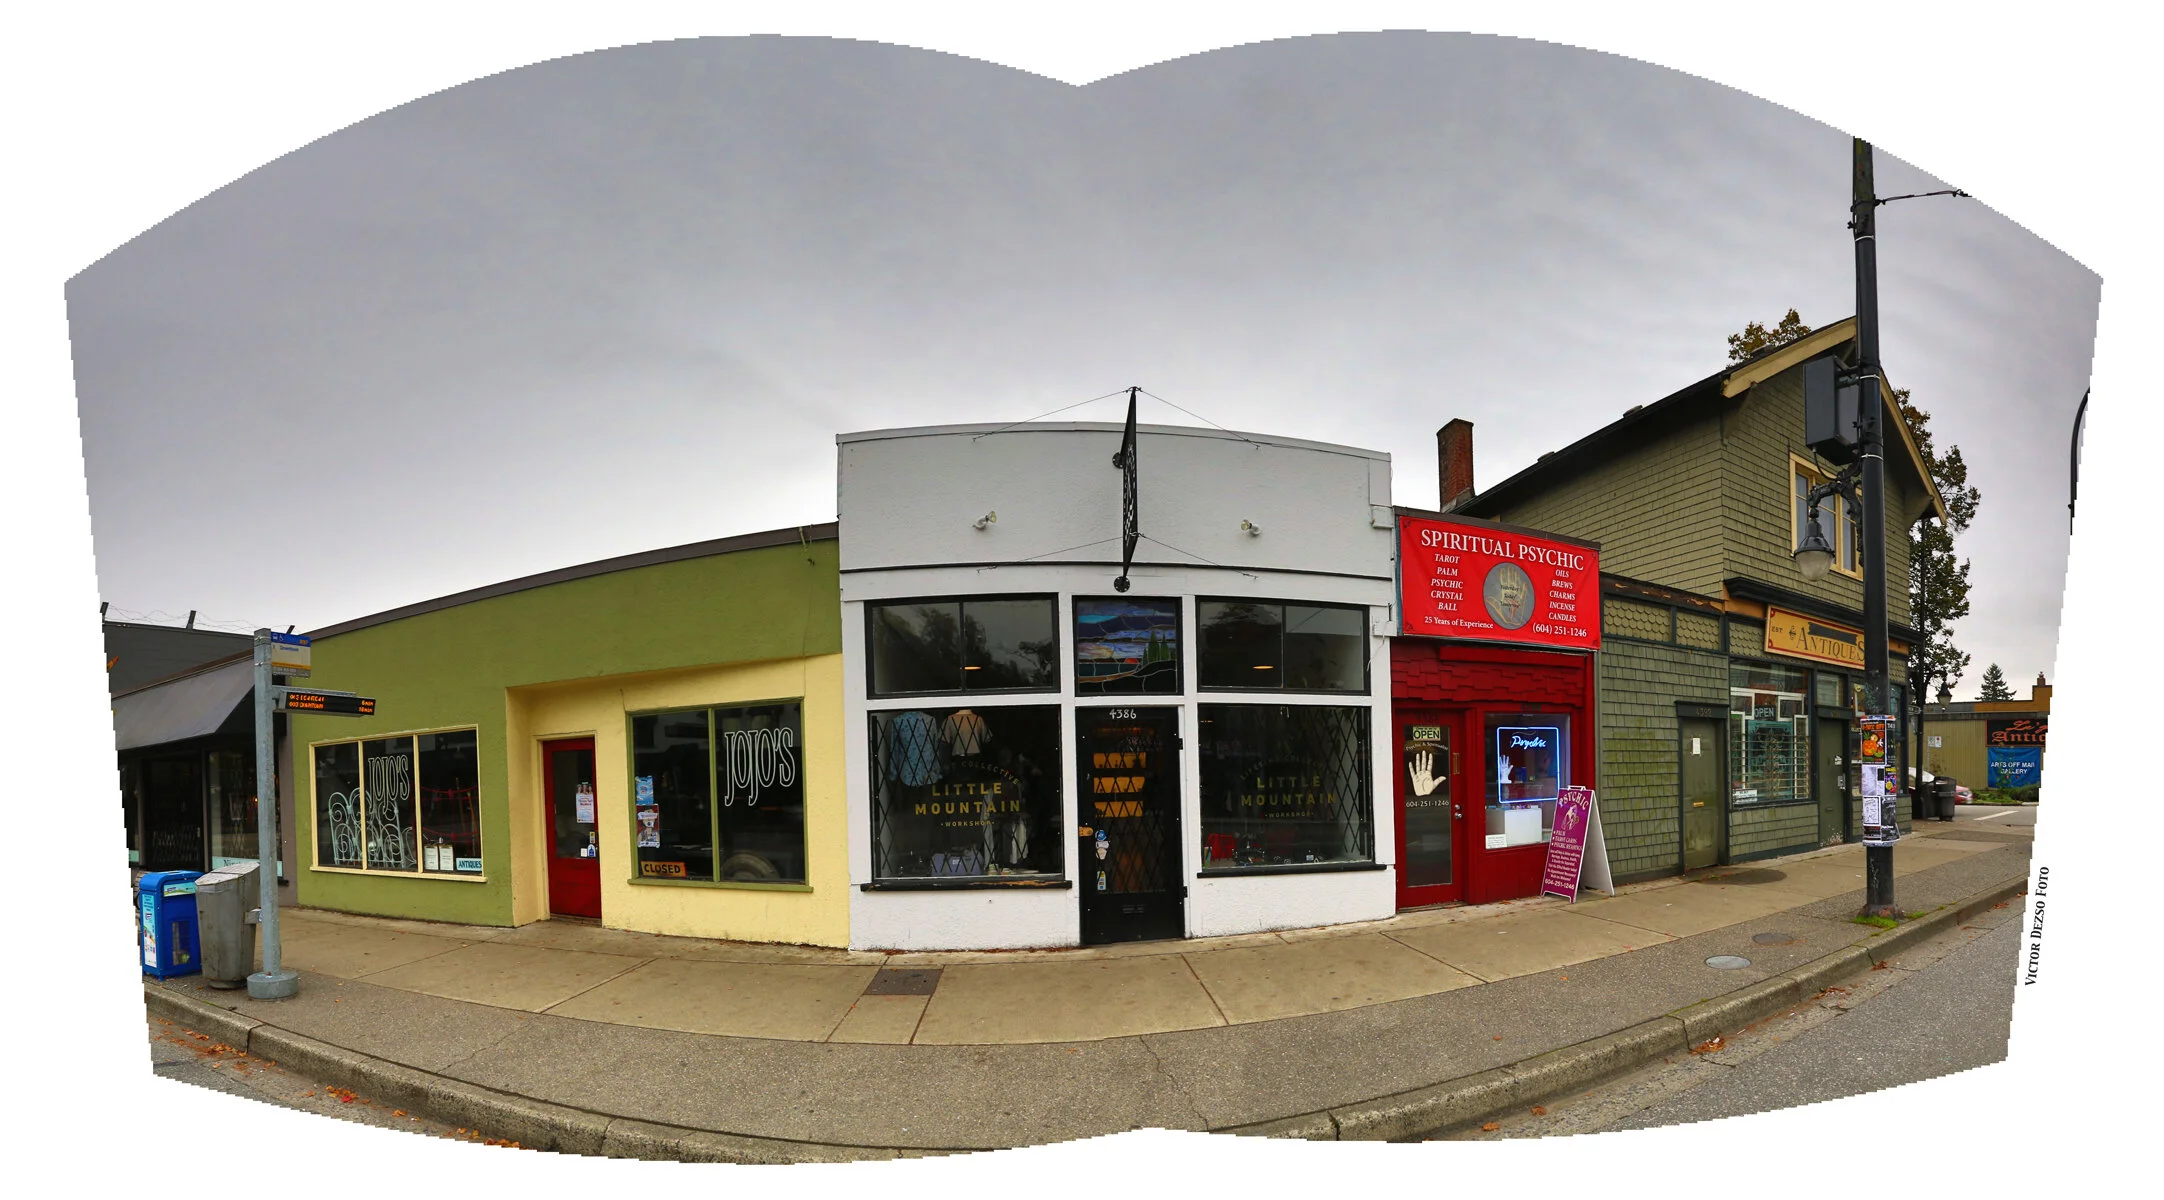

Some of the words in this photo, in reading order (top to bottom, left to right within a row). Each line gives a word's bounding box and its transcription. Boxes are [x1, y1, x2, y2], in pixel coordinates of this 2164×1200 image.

[1421, 529, 1515, 559] SPIRITUAL
[1518, 543, 1584, 571] PSYCHIC
[1434, 553, 1460, 564] TAROT
[1436, 566, 1458, 577] PALM
[1555, 569, 1570, 578] OILS
[1430, 578, 1464, 589] PSYCHIC
[1551, 580, 1573, 590] BREWS
[1430, 589, 1464, 601] CRYSTAL
[1549, 590, 1576, 601] CHARMS
[1437, 601, 1458, 612] BALL
[1549, 601, 1576, 612] INCENSE
[1424, 616, 1433, 624] 25
[1434, 616, 1451, 627] Years
[1451, 617, 1459, 626] of
[1459, 619, 1494, 630] Experience
[1548, 612, 1577, 623] CANDLES
[1532, 622, 1553, 635] (604)
[1554, 625, 1588, 638] 251-1246
[1771, 626, 1783, 634] EST
[1109, 708, 1137, 719] 4386
[1754, 707, 1775, 718] OPEN
[1413, 730, 1440, 740] OPEN
[1510, 735, 1547, 750] Psychic
[724, 727, 796, 807] JOJO'S
[960, 760, 1020, 786] COLLECTIVE
[368, 754, 411, 815] JOJO'S
[1256, 775, 1321, 789] LITTLE
[931, 782, 1002, 797] LITTLE
[1241, 793, 1337, 807] MOUNTAIN
[1405, 800, 1450, 808] 604-251-1246
[1558, 791, 1589, 811] PSYCHIC
[915, 799, 1020, 816] MOUNTAIN
[1267, 811, 1312, 819] WORKSHOP
[943, 820, 992, 828] WORKSHOP
[458, 860, 482, 869] ANTIQUES
[644, 863, 681, 874] CLOSED
[1544, 878, 1575, 890] 604-251-1246
